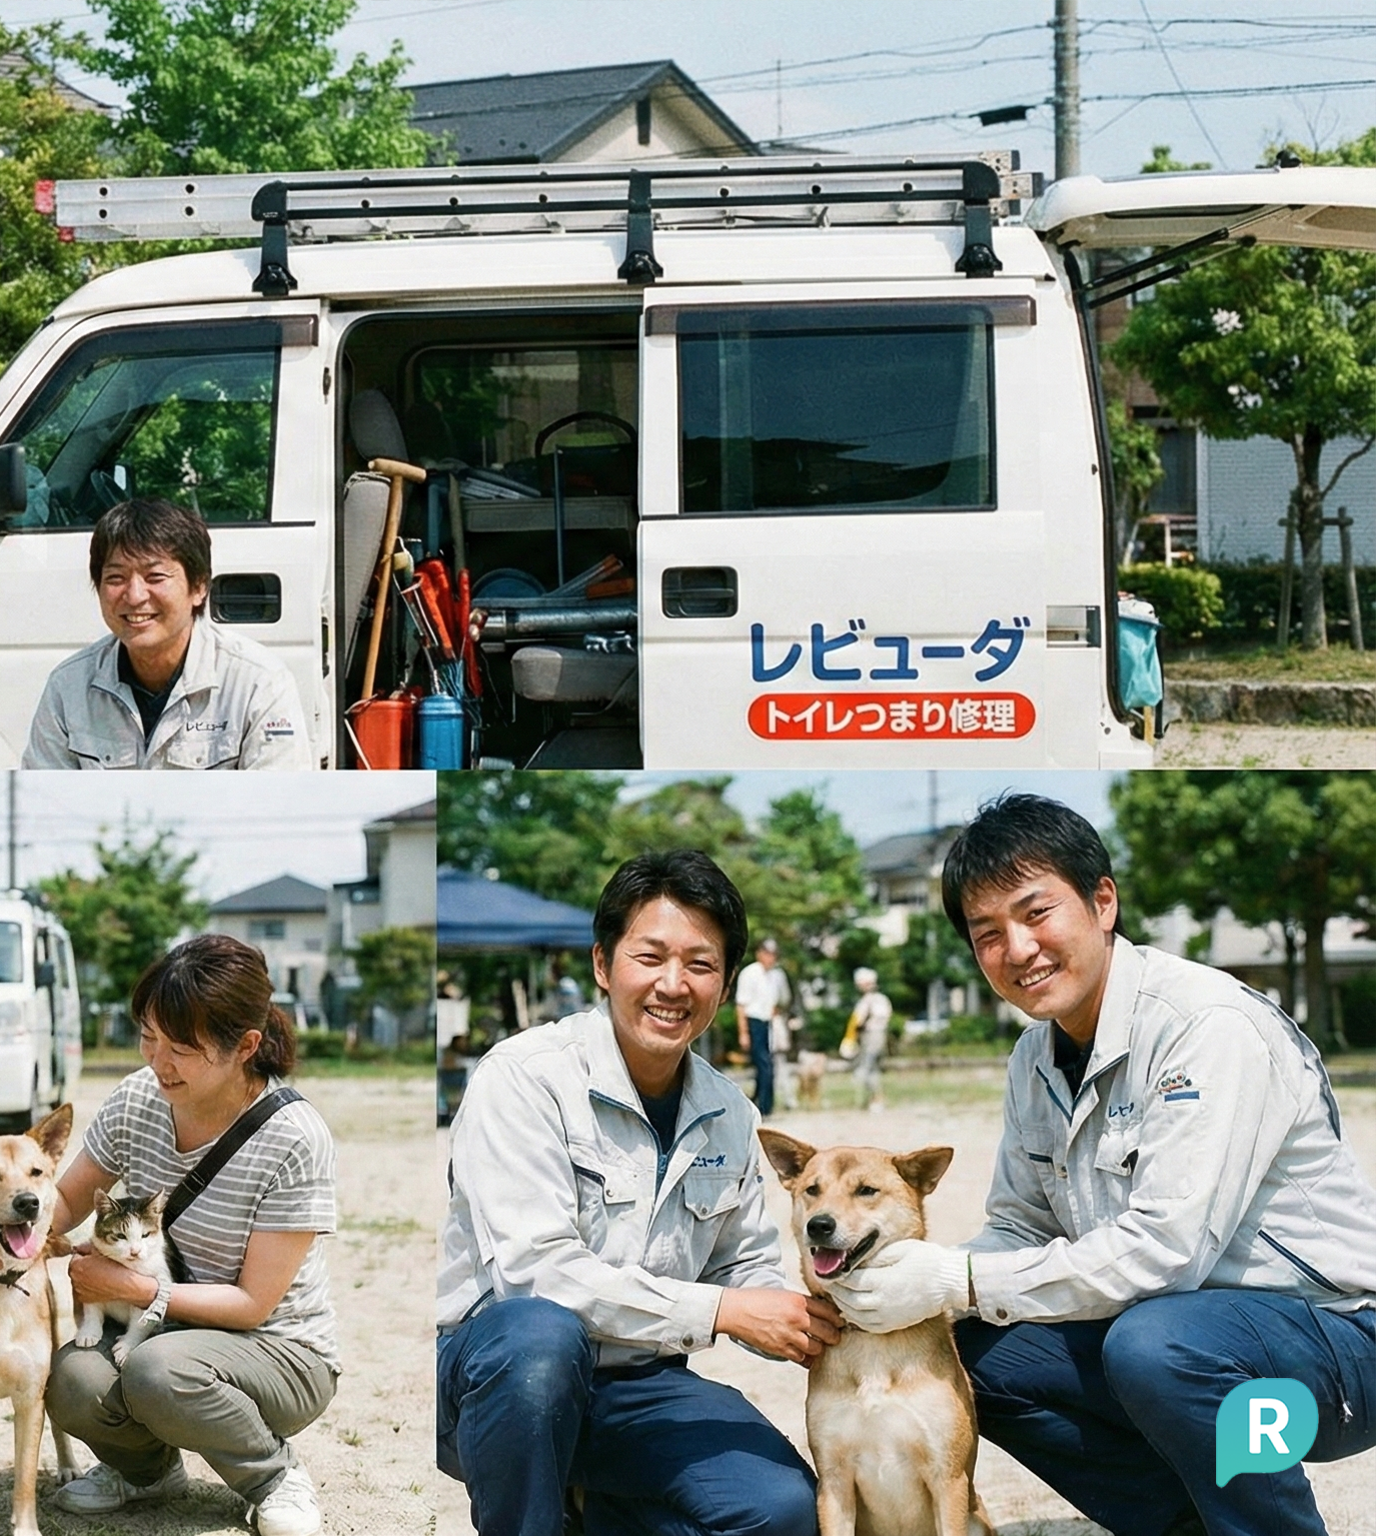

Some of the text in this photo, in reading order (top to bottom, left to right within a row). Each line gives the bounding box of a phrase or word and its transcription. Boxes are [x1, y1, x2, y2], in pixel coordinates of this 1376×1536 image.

[750, 616, 1031, 682] レビューダ
[767, 699, 1016, 734] トイレつまり修理
